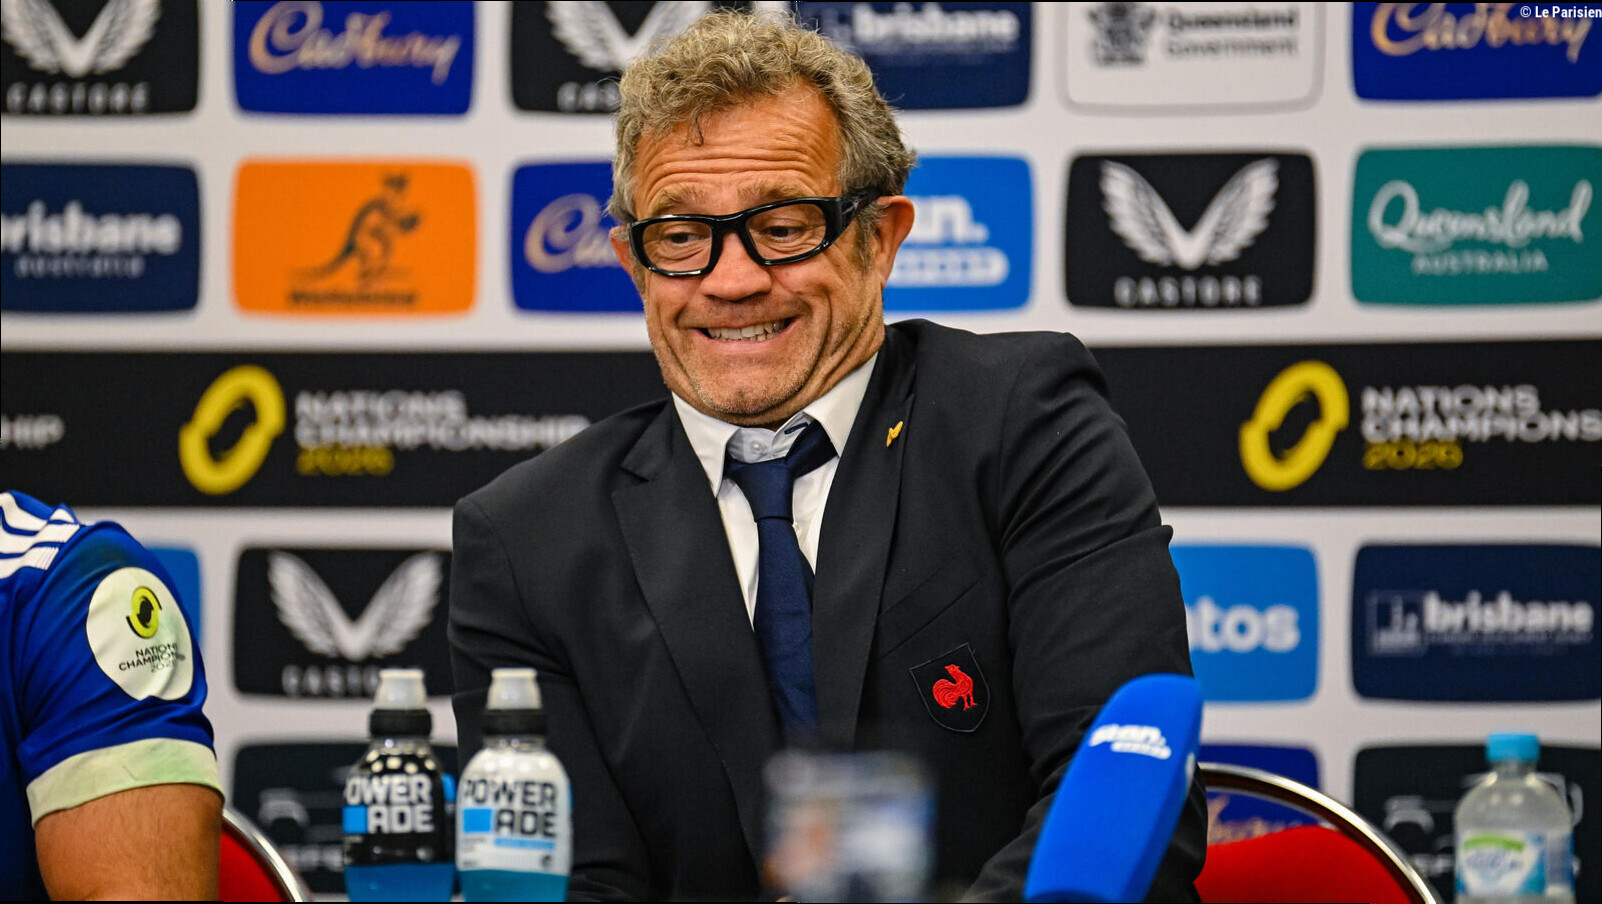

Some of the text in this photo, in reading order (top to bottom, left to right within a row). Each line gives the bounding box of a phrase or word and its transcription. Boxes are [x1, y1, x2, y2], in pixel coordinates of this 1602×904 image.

[6, 81, 150, 114] CASTORE
[1367, 179, 1594, 252] Queensland
[1410, 249, 1550, 276] AUSTRALIA
[1113, 275, 1263, 308] CASTORE
[1361, 384, 1540, 415] NATIONS
[1361, 409, 1602, 443] CHAMPIONS
[1186, 595, 1301, 653] tos
[1423, 589, 1594, 633] brisbane
[281, 664, 381, 697] CASTO
[345, 774, 433, 805] OWER
[367, 804, 434, 834] ADE
[496, 808, 557, 838] ADE
